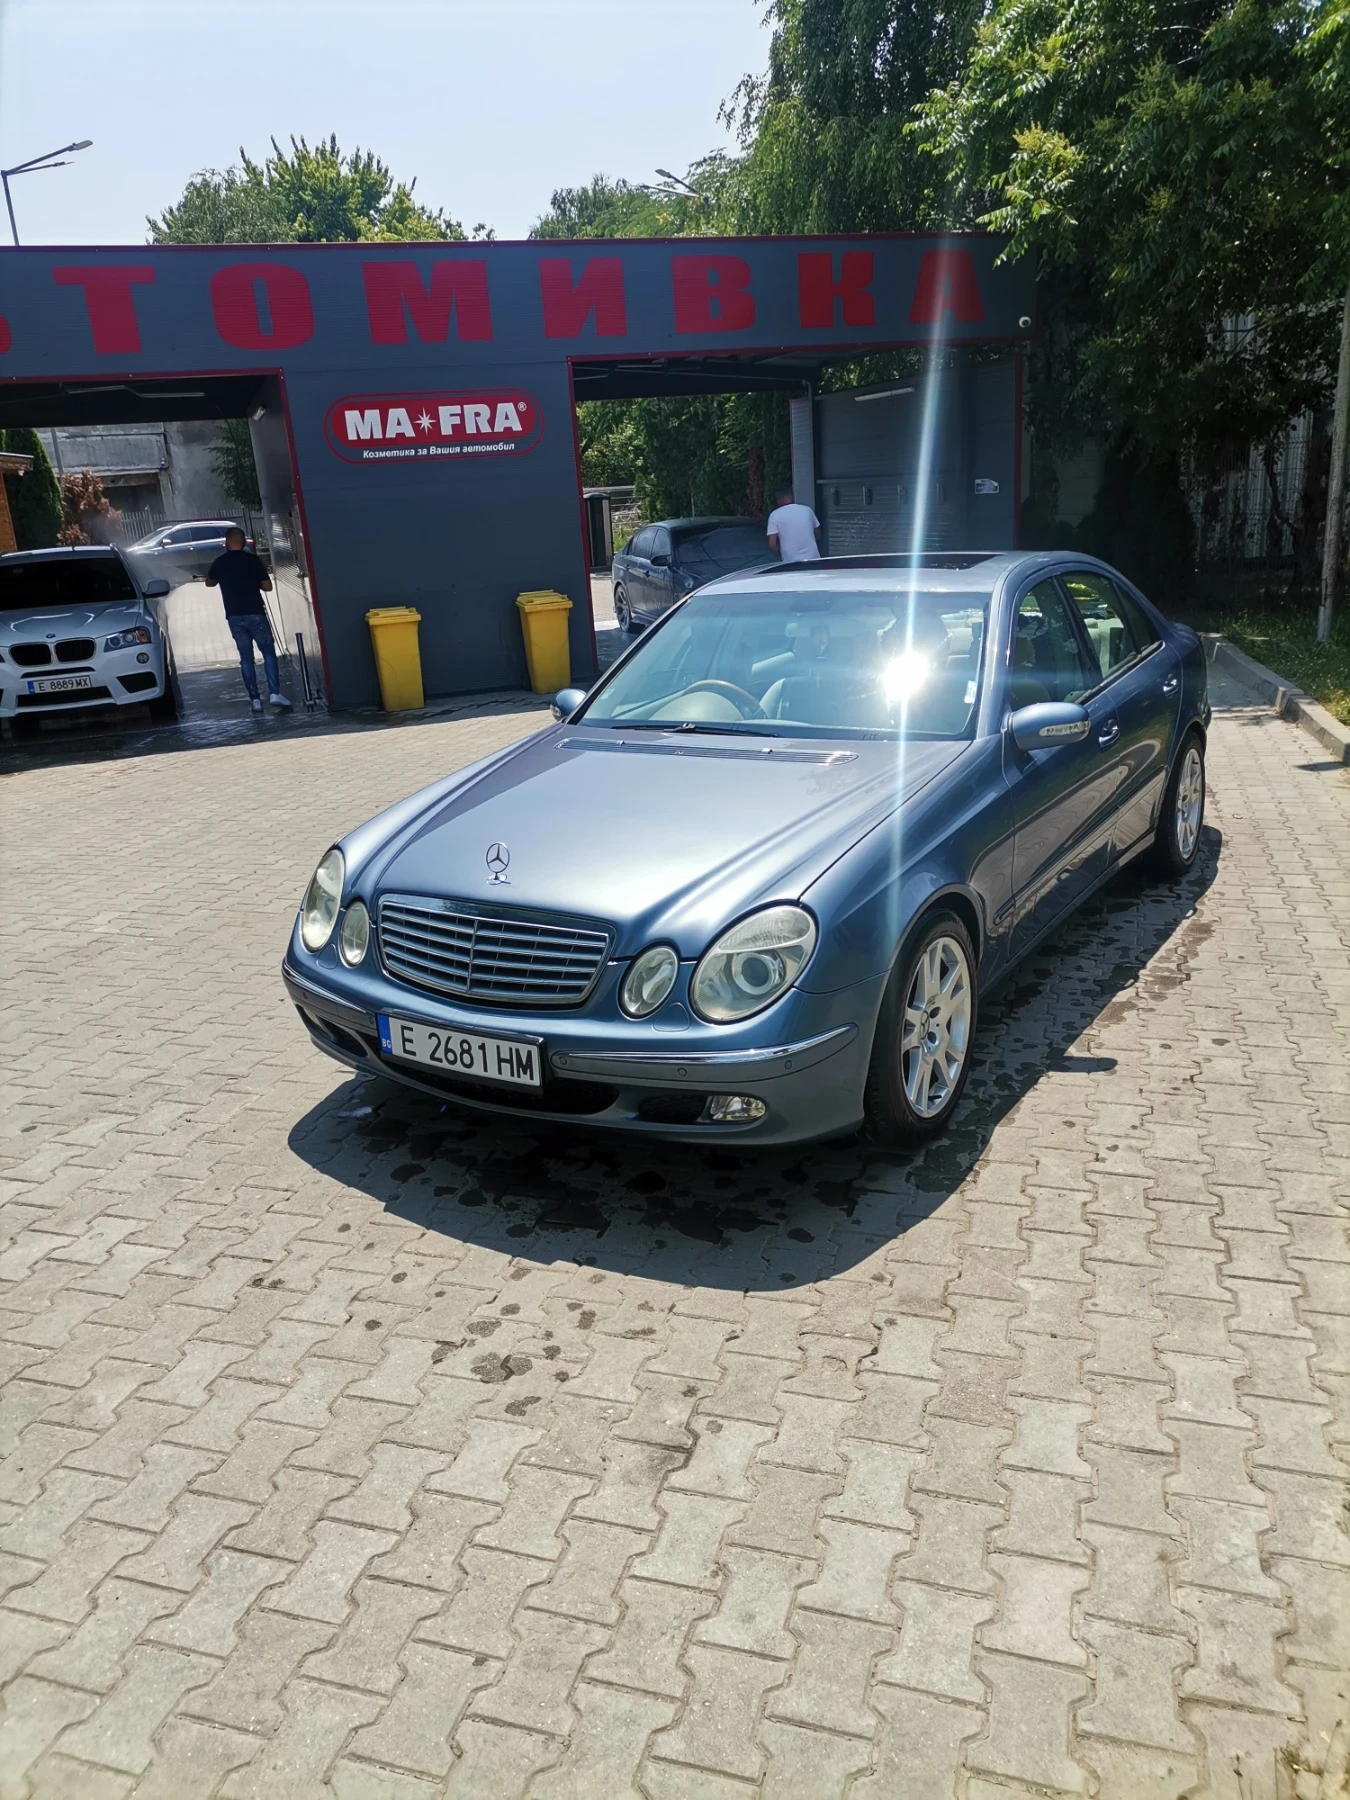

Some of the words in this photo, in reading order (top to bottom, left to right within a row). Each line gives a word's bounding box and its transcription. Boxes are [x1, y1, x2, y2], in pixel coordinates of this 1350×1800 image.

[0, 249, 986, 356] ТОМИВКА
[363, 449, 415, 459] Козметика
[417, 448, 428, 456] за
[429, 445, 461, 455] Вашия
[462, 442, 515, 453] автомобил
[38, 682, 46, 691] E
[50, 679, 74, 690] 8889
[75, 677, 89, 687] MX
[381, 1037, 392, 1049] BG
[400, 1024, 417, 1057] E
[428, 1032, 489, 1073] 2681
[496, 1044, 535, 1081] HM
